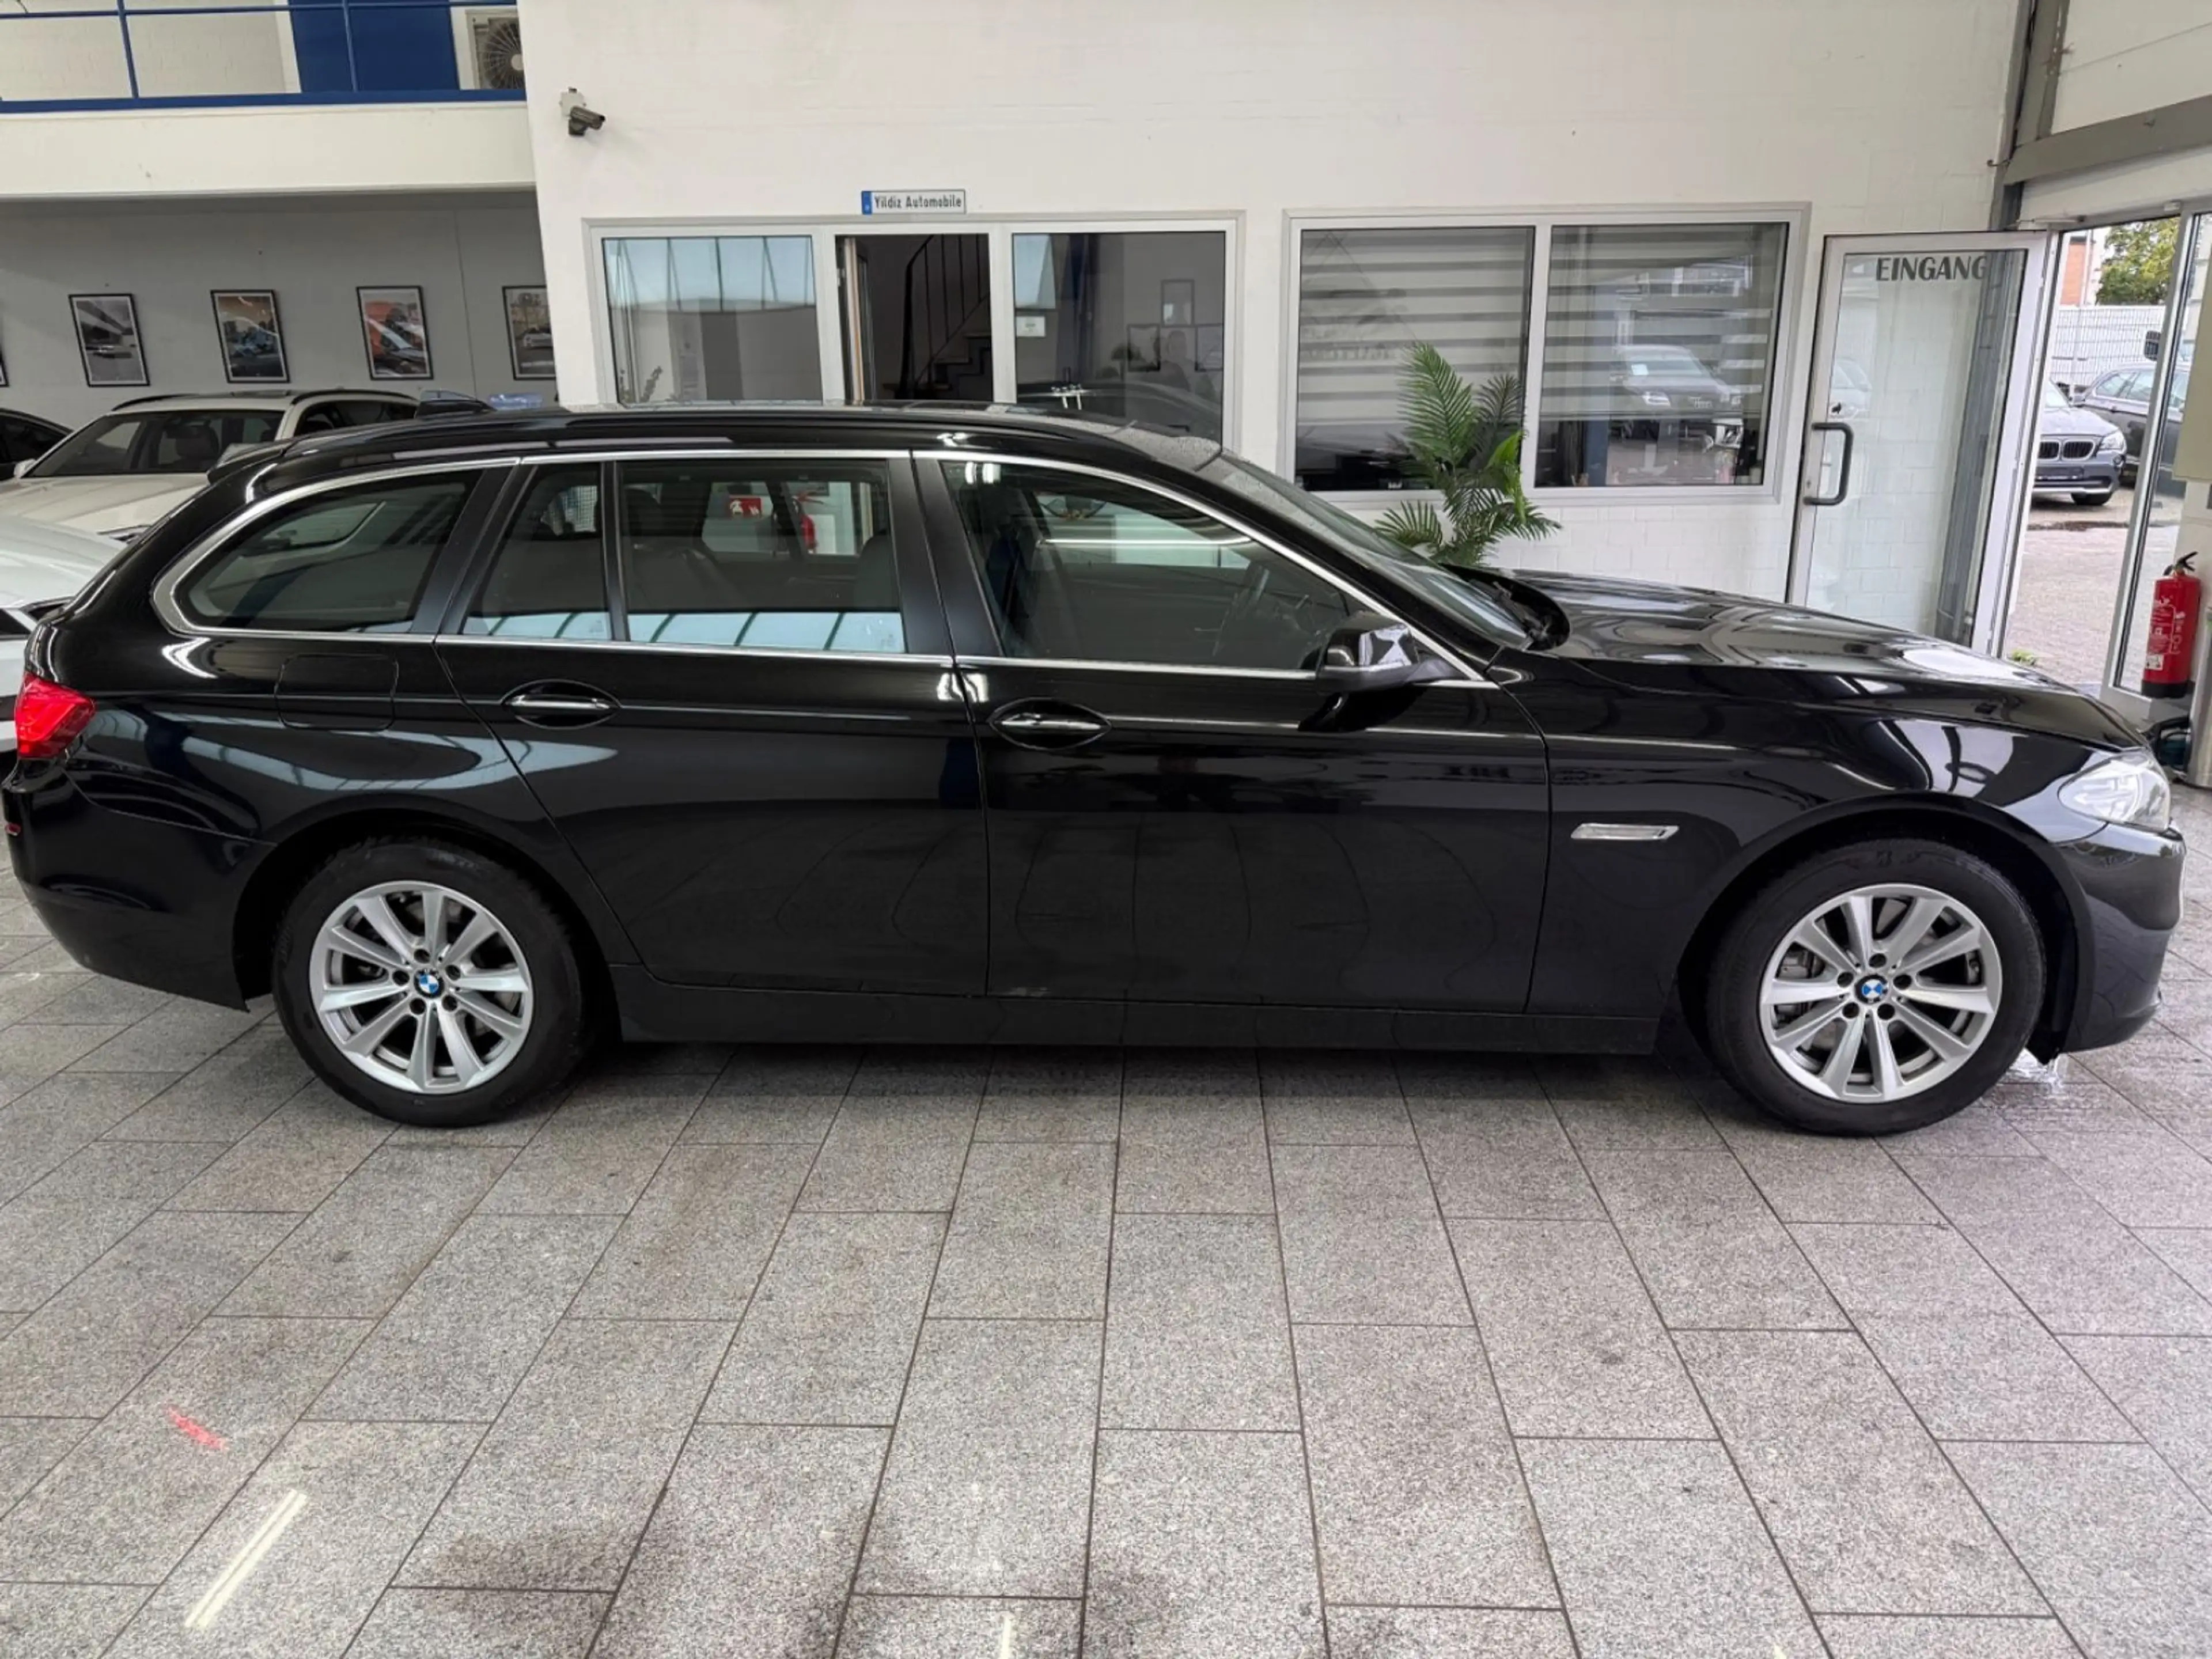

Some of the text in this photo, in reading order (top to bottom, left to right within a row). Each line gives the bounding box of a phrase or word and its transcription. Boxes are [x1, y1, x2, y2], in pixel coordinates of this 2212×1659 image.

[874, 196, 902, 209] Yildiz
[906, 194, 961, 207] Automobile
[1876, 256, 1988, 281] EINGANG
